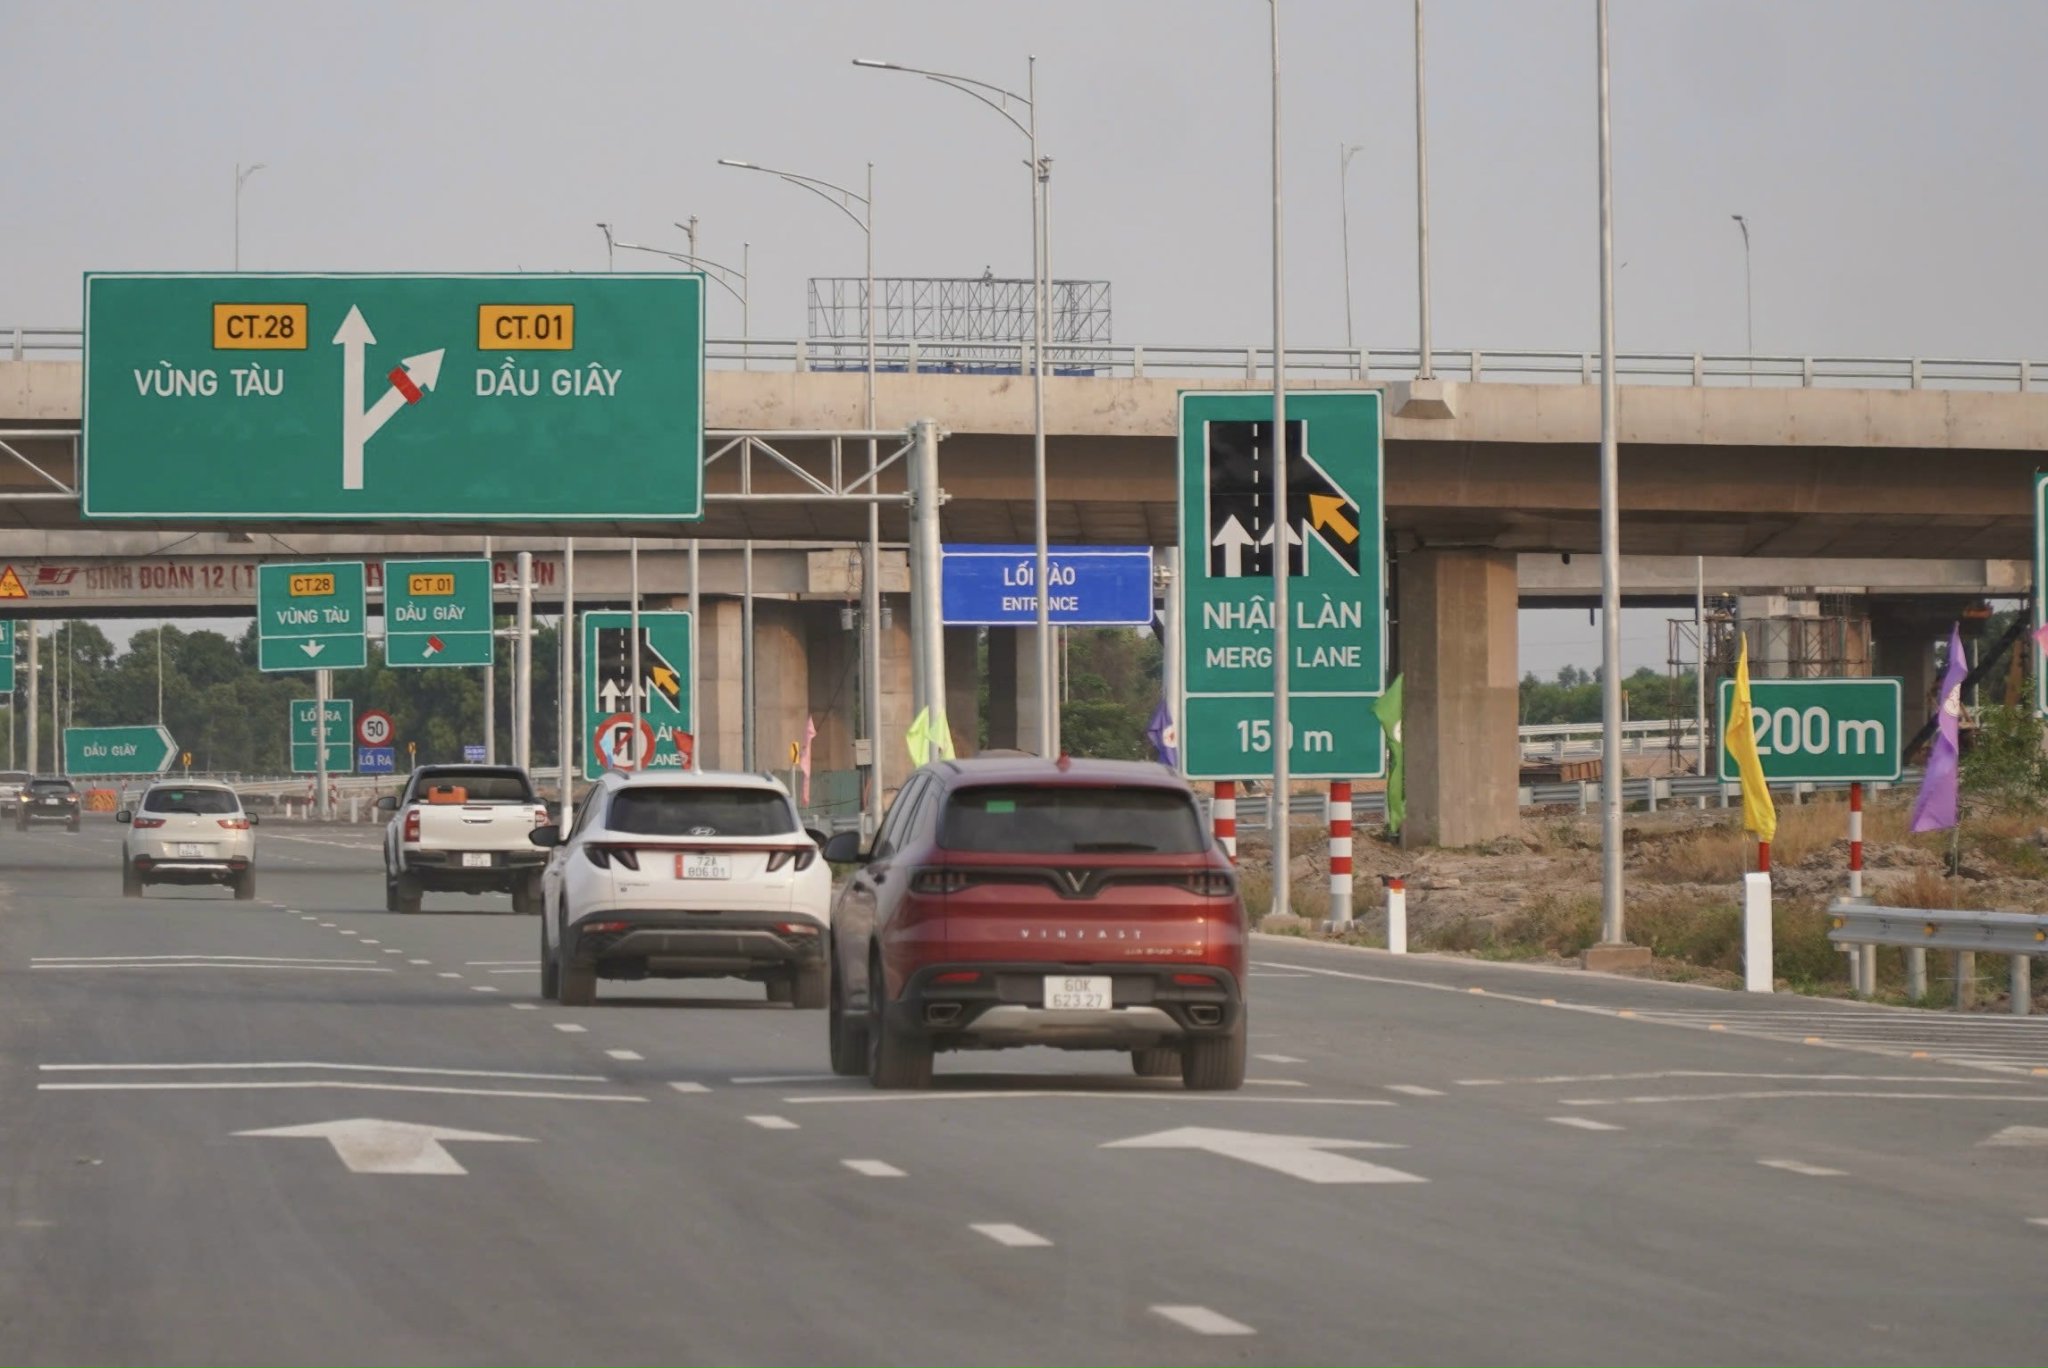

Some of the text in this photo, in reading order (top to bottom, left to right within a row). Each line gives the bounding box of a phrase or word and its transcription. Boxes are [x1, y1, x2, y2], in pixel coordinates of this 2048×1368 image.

[226, 315, 294, 339] CT.28
[495, 315, 563, 340] CT.01
[134, 360, 284, 396] VŨNG TÀU
[476, 357, 622, 396] DẦU GIÂY
[139, 561, 194, 589] ĐOÀN
[201, 565, 224, 588] 12
[1004, 560, 1076, 586] LỐI ÀO
[294, 578, 331, 592] CT.28
[412, 577, 451, 592] CT.01
[323, 605, 350, 623] TÀU
[395, 601, 466, 622] DẦU GIÂY
[1002, 597, 1078, 612] ENTRNCE
[1297, 593, 1362, 629] LÀN
[1206, 646, 1362, 669] MERG LANE
[324, 709, 342, 722] RA
[367, 721, 384, 738] 50
[1304, 730, 1334, 753] m
[377, 754, 393, 767] RA
[1021, 929, 1142, 939] VINFAST
[1065, 978, 1091, 992] 60K
